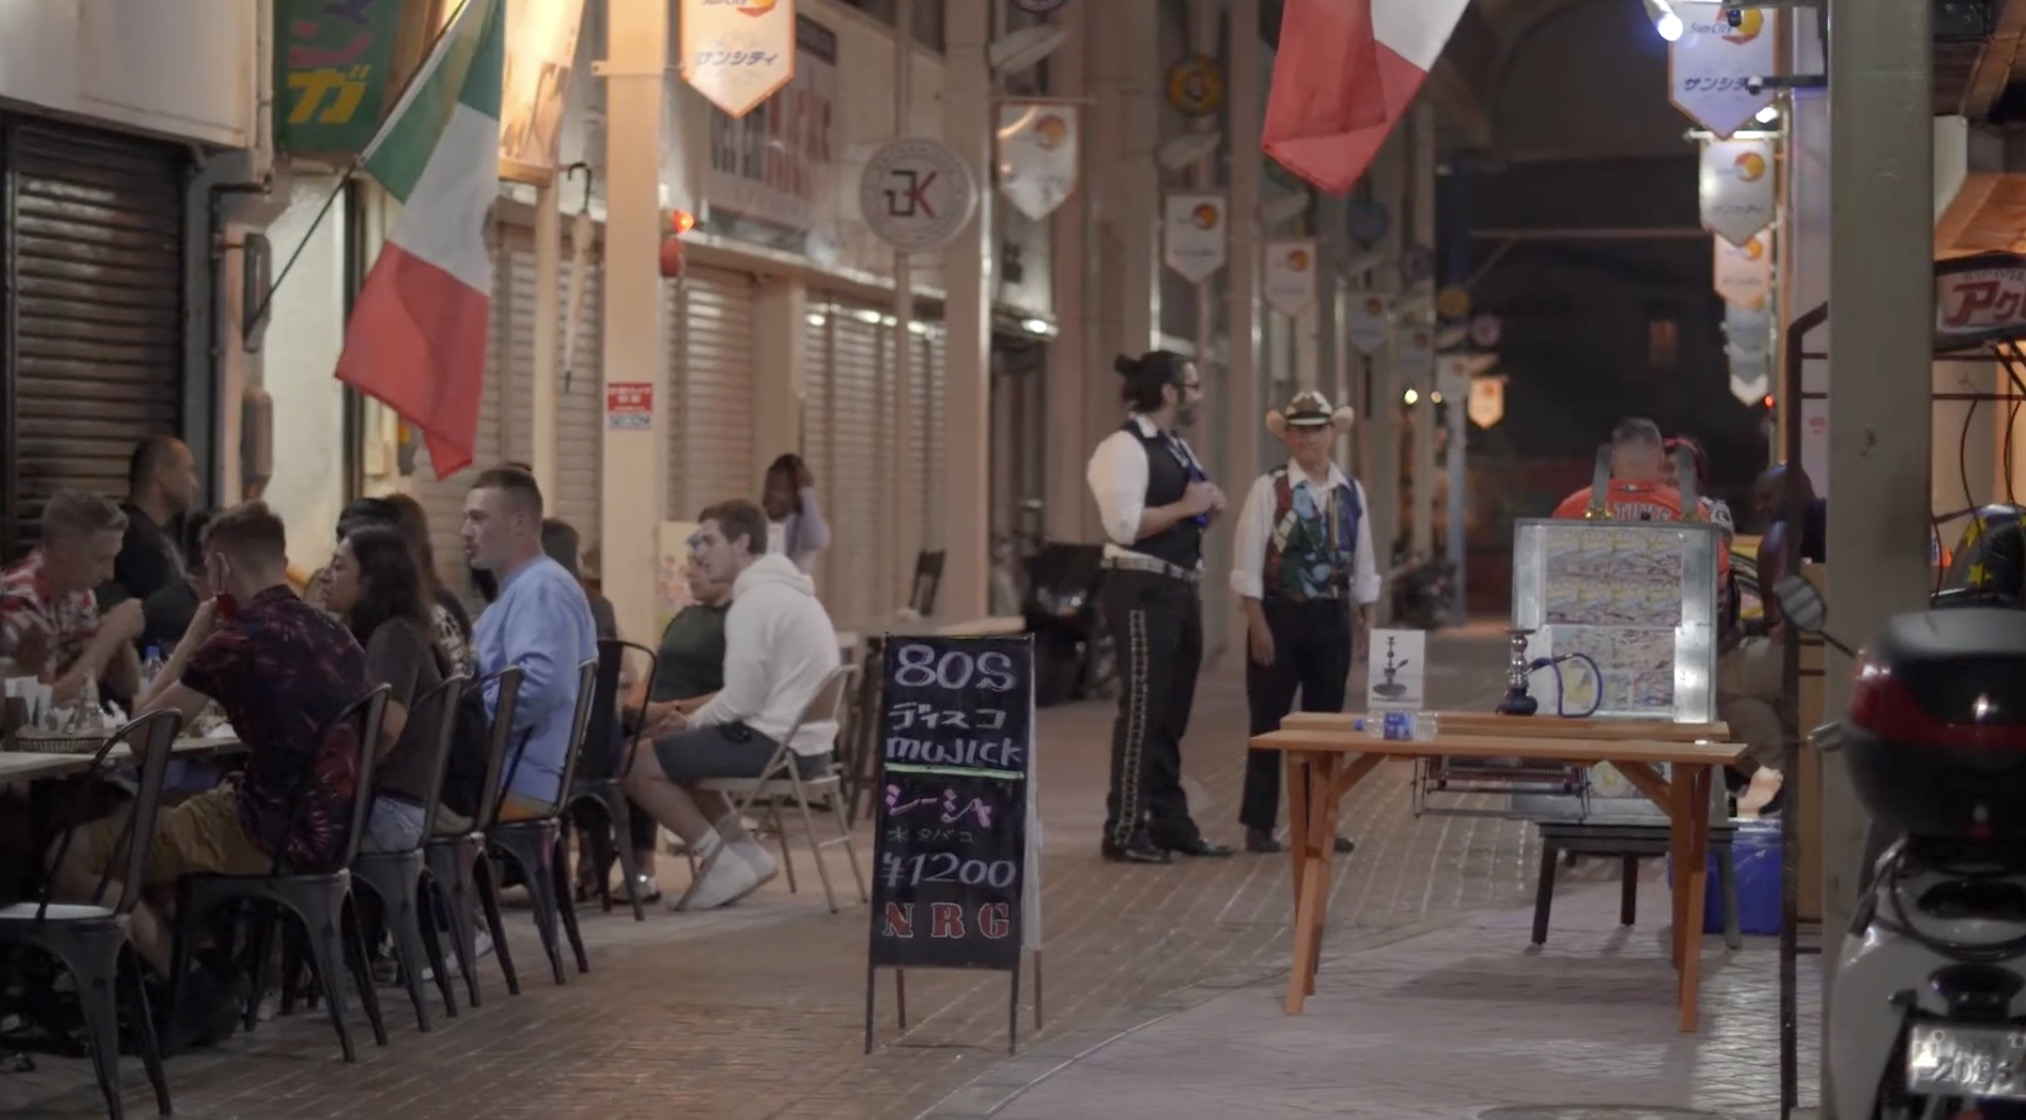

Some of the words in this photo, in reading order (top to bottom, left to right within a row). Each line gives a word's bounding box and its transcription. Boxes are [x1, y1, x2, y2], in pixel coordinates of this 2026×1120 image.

[695, 51, 778, 66] サンシティ
[888, 702, 1007, 731] ディスコ
[885, 784, 992, 828] シーシャ
[882, 852, 1017, 888] ¥1200
